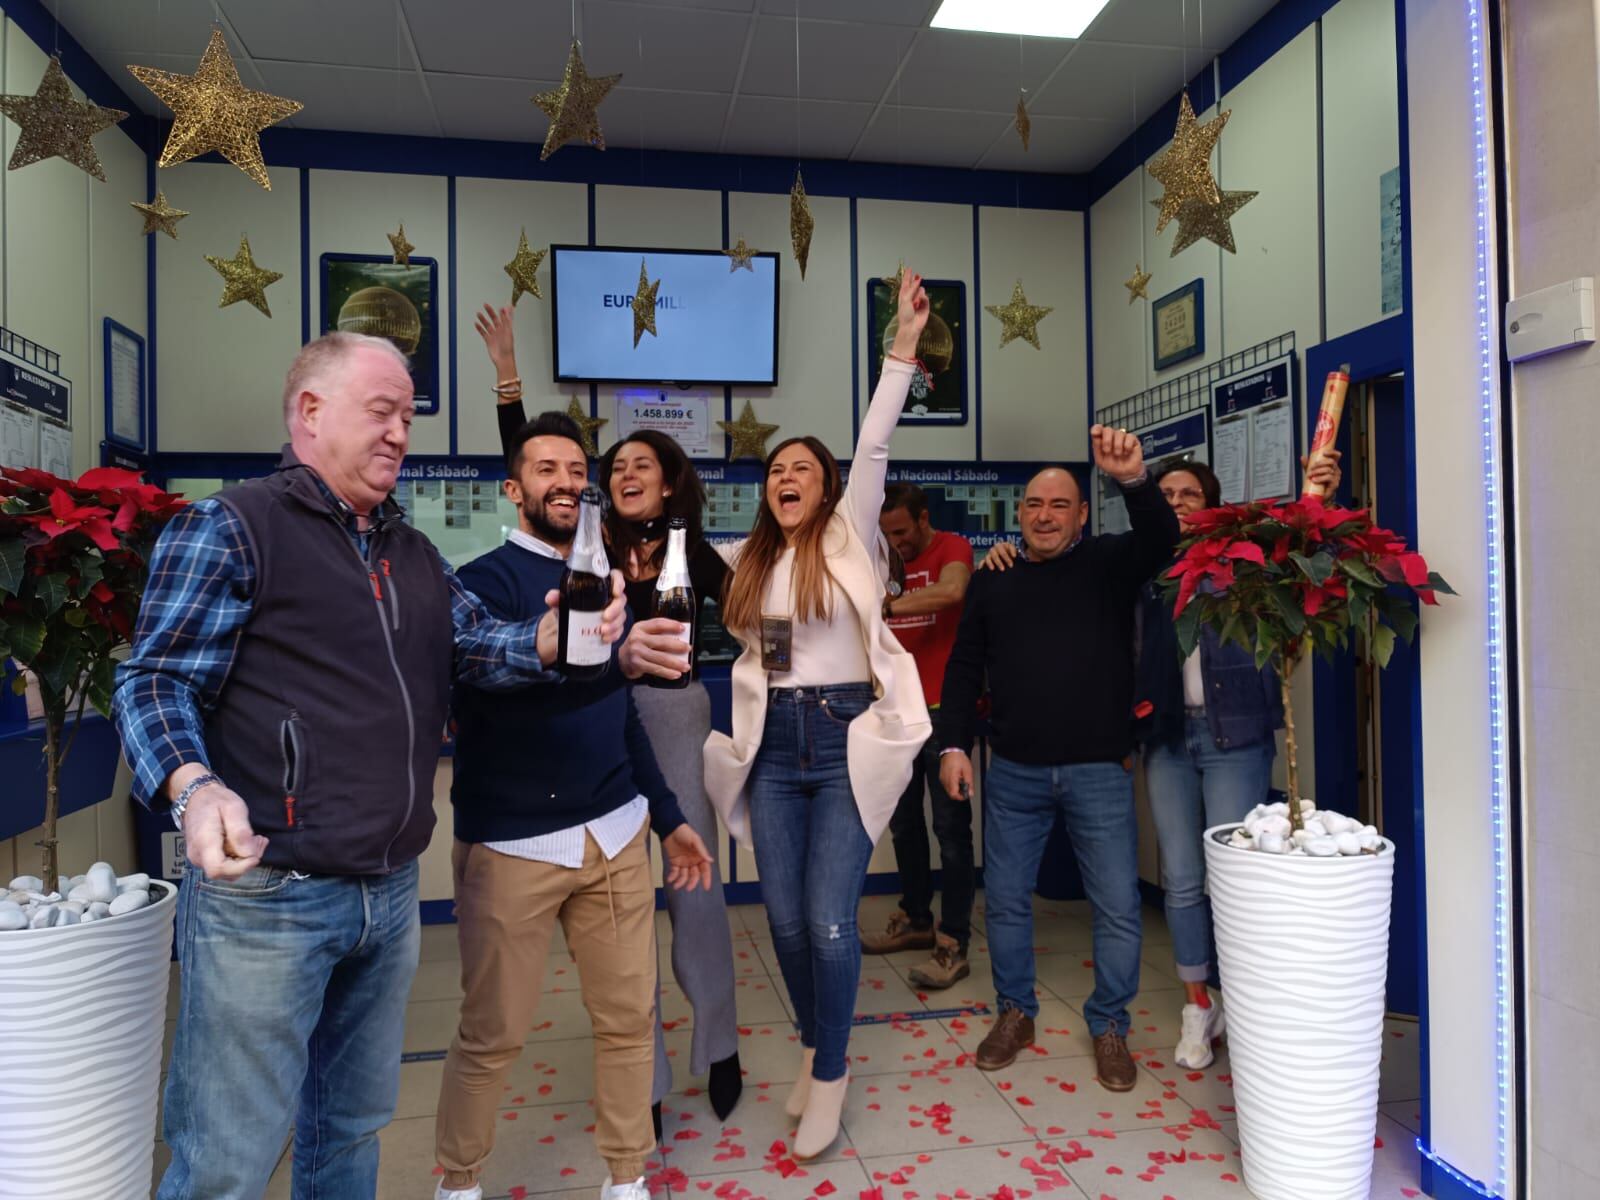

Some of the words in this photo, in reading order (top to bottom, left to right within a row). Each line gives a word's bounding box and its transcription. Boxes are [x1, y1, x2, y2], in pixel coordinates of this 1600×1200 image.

[633, 408, 684, 419] 1.458.899
[426, 465, 479, 478] Sábado
[696, 467, 725, 480] onal
[900, 468, 952, 481] Nacional
[954, 468, 999, 481] Sábado
[966, 534, 1004, 546] otería
